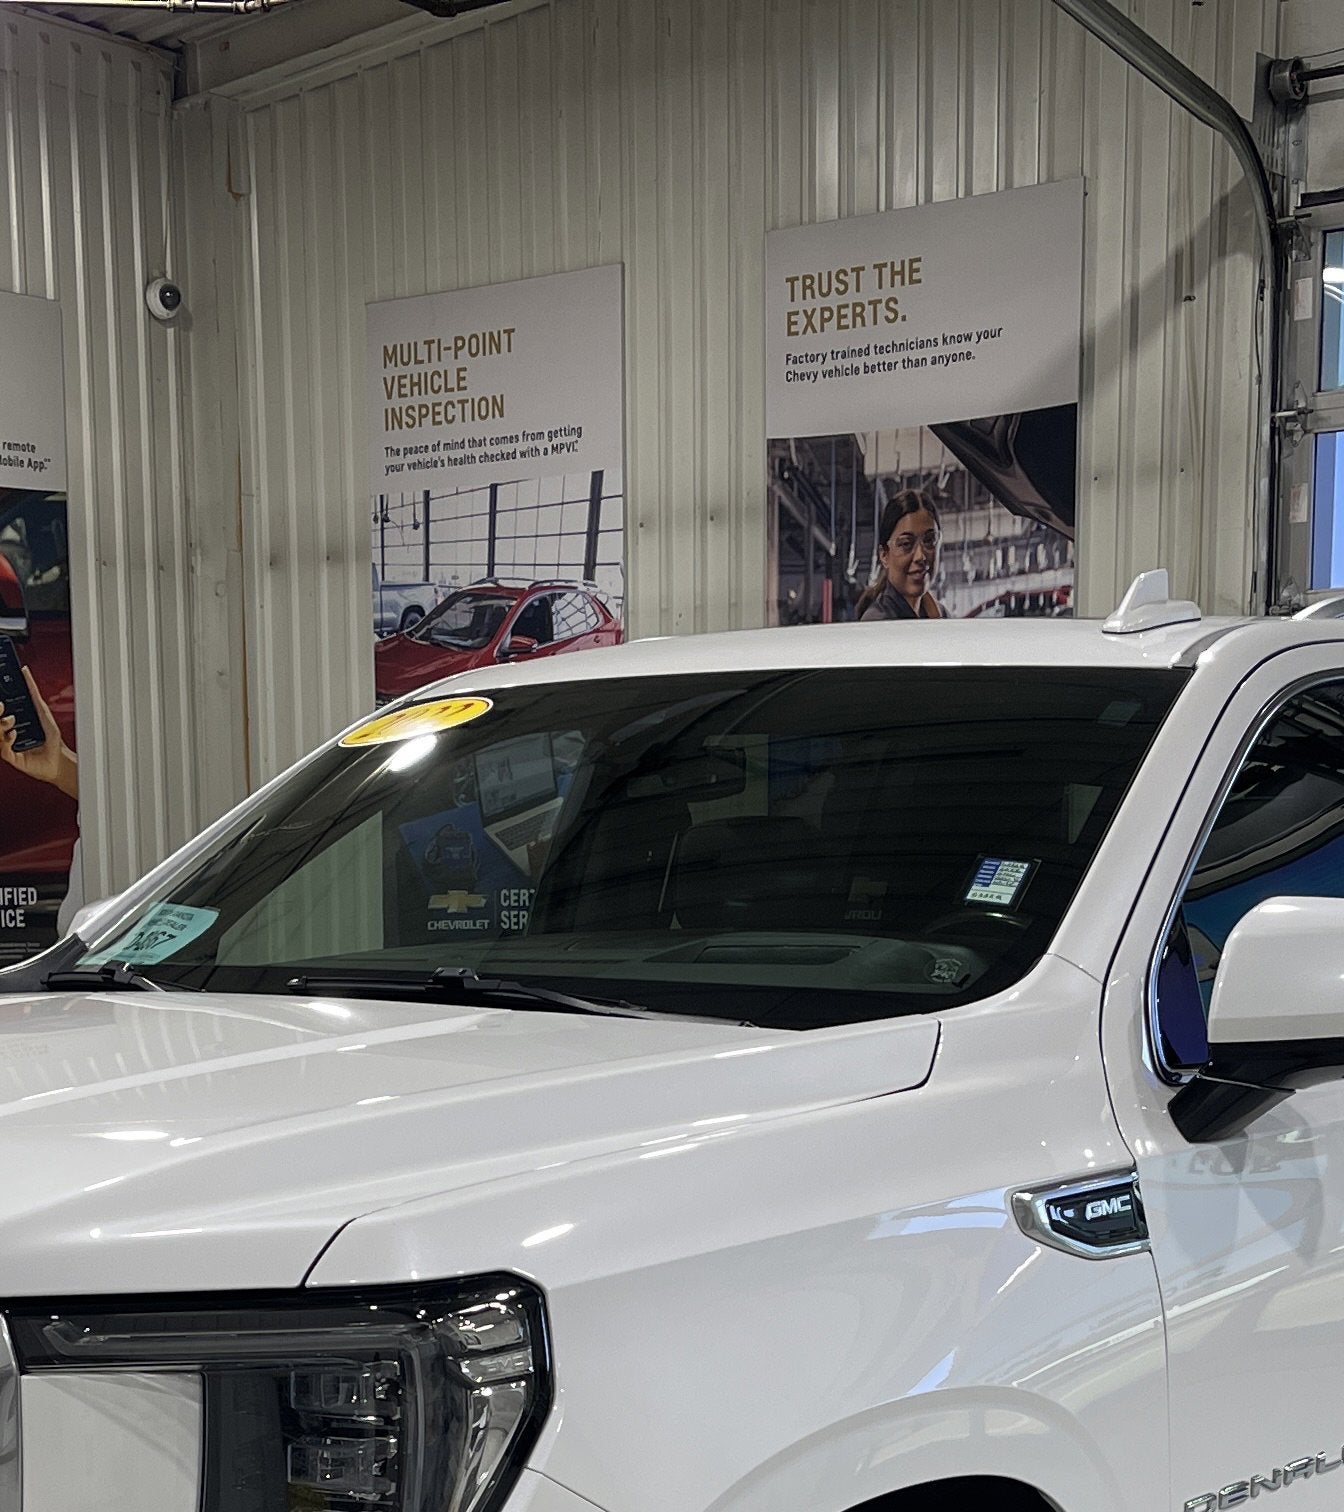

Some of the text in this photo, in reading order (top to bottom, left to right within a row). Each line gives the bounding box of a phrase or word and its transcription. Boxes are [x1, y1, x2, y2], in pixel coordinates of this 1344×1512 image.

[785, 256, 922, 302] TRUST THE
[786, 297, 907, 337] EXPERTS.
[383, 328, 516, 369] MULTI-POINT
[785, 327, 1004, 366] Factory trained technicians know your
[383, 366, 468, 400] VEHICLE
[785, 350, 976, 384] Chevy vehicle better than anyone.
[384, 394, 505, 432] INSPECTION
[2, 440, 36, 454] remote
[384, 424, 583, 460] The peace of mind that comes from getting
[384, 463, 404, 476] your
[407, 455, 445, 472] vehicle's
[447, 452, 477, 467] health
[478, 447, 517, 464] checked
[519, 445, 541, 460] with
[543, 447, 549, 456] a
[427, 919, 490, 931] CHEVROLET
[1085, 1195, 1132, 1221] GMC
